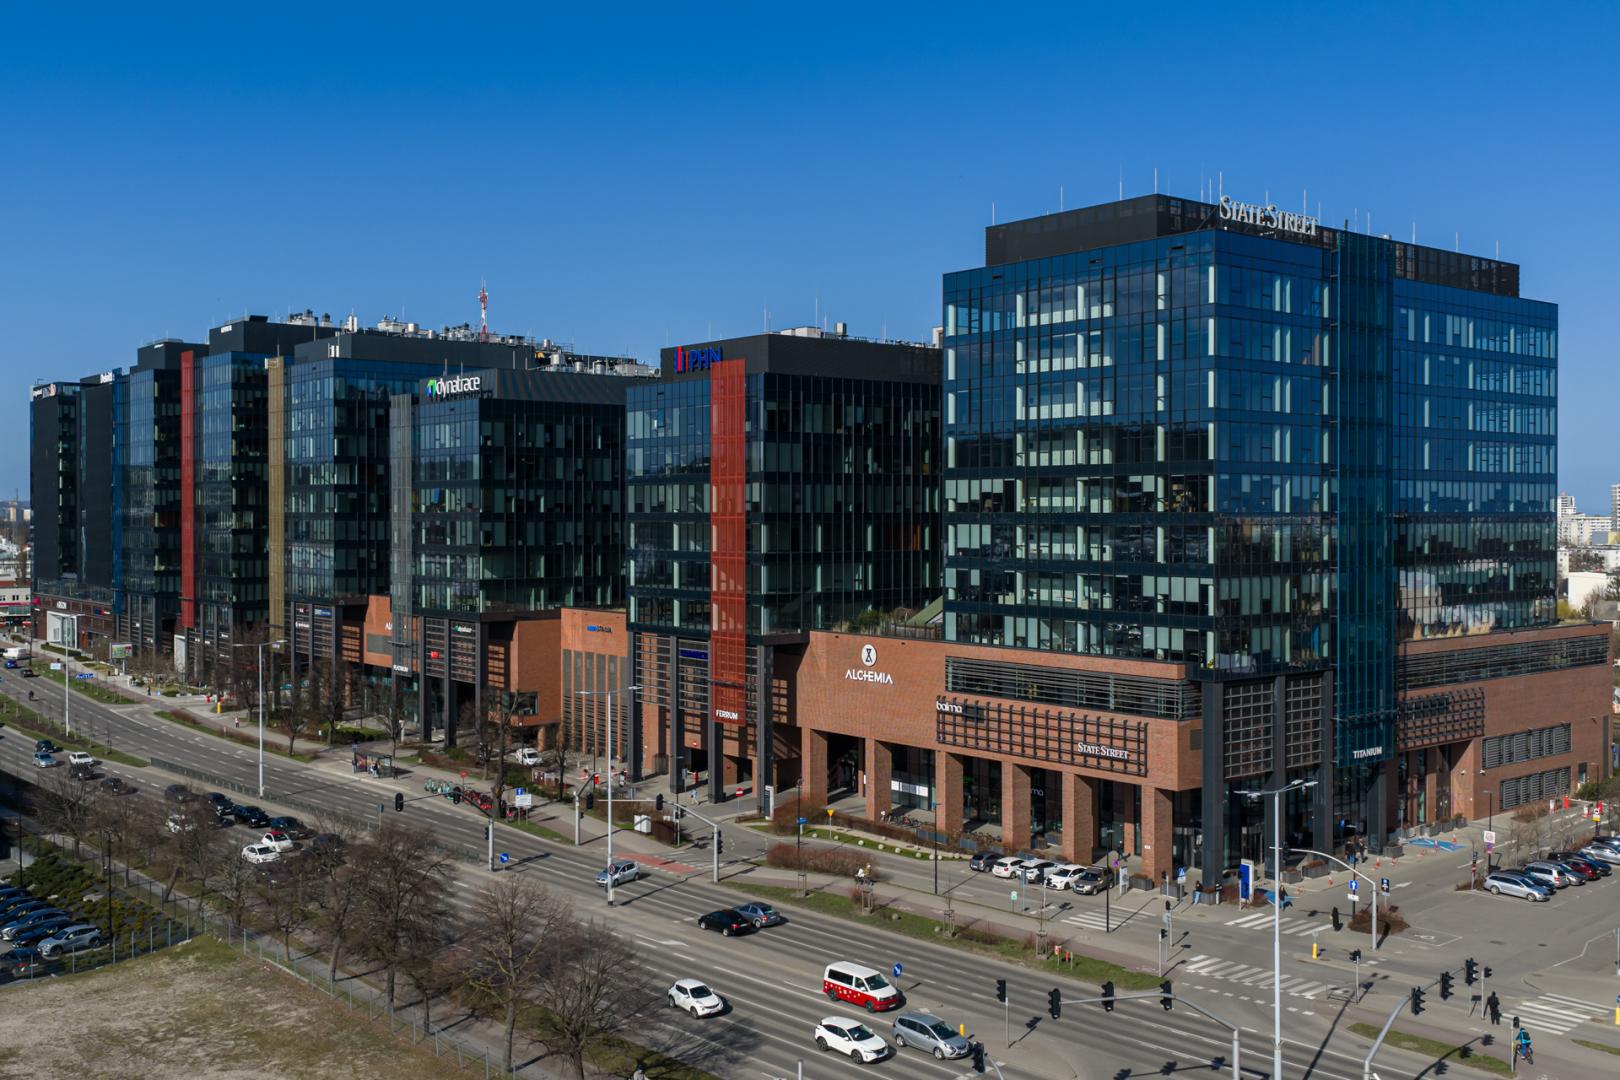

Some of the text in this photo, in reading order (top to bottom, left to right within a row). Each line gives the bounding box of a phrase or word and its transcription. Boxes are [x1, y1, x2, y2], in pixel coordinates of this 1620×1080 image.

[1220, 195, 1319, 236] STATE STREET
[689, 346, 723, 369] PHN
[436, 376, 480, 398] dynatrace
[845, 669, 893, 684] ALCHEMIA
[715, 709, 738, 720] FERRUM
[936, 700, 963, 713] balma
[1078, 741, 1129, 759] STATE STREET
[1352, 746, 1382, 759] TITANIUM
